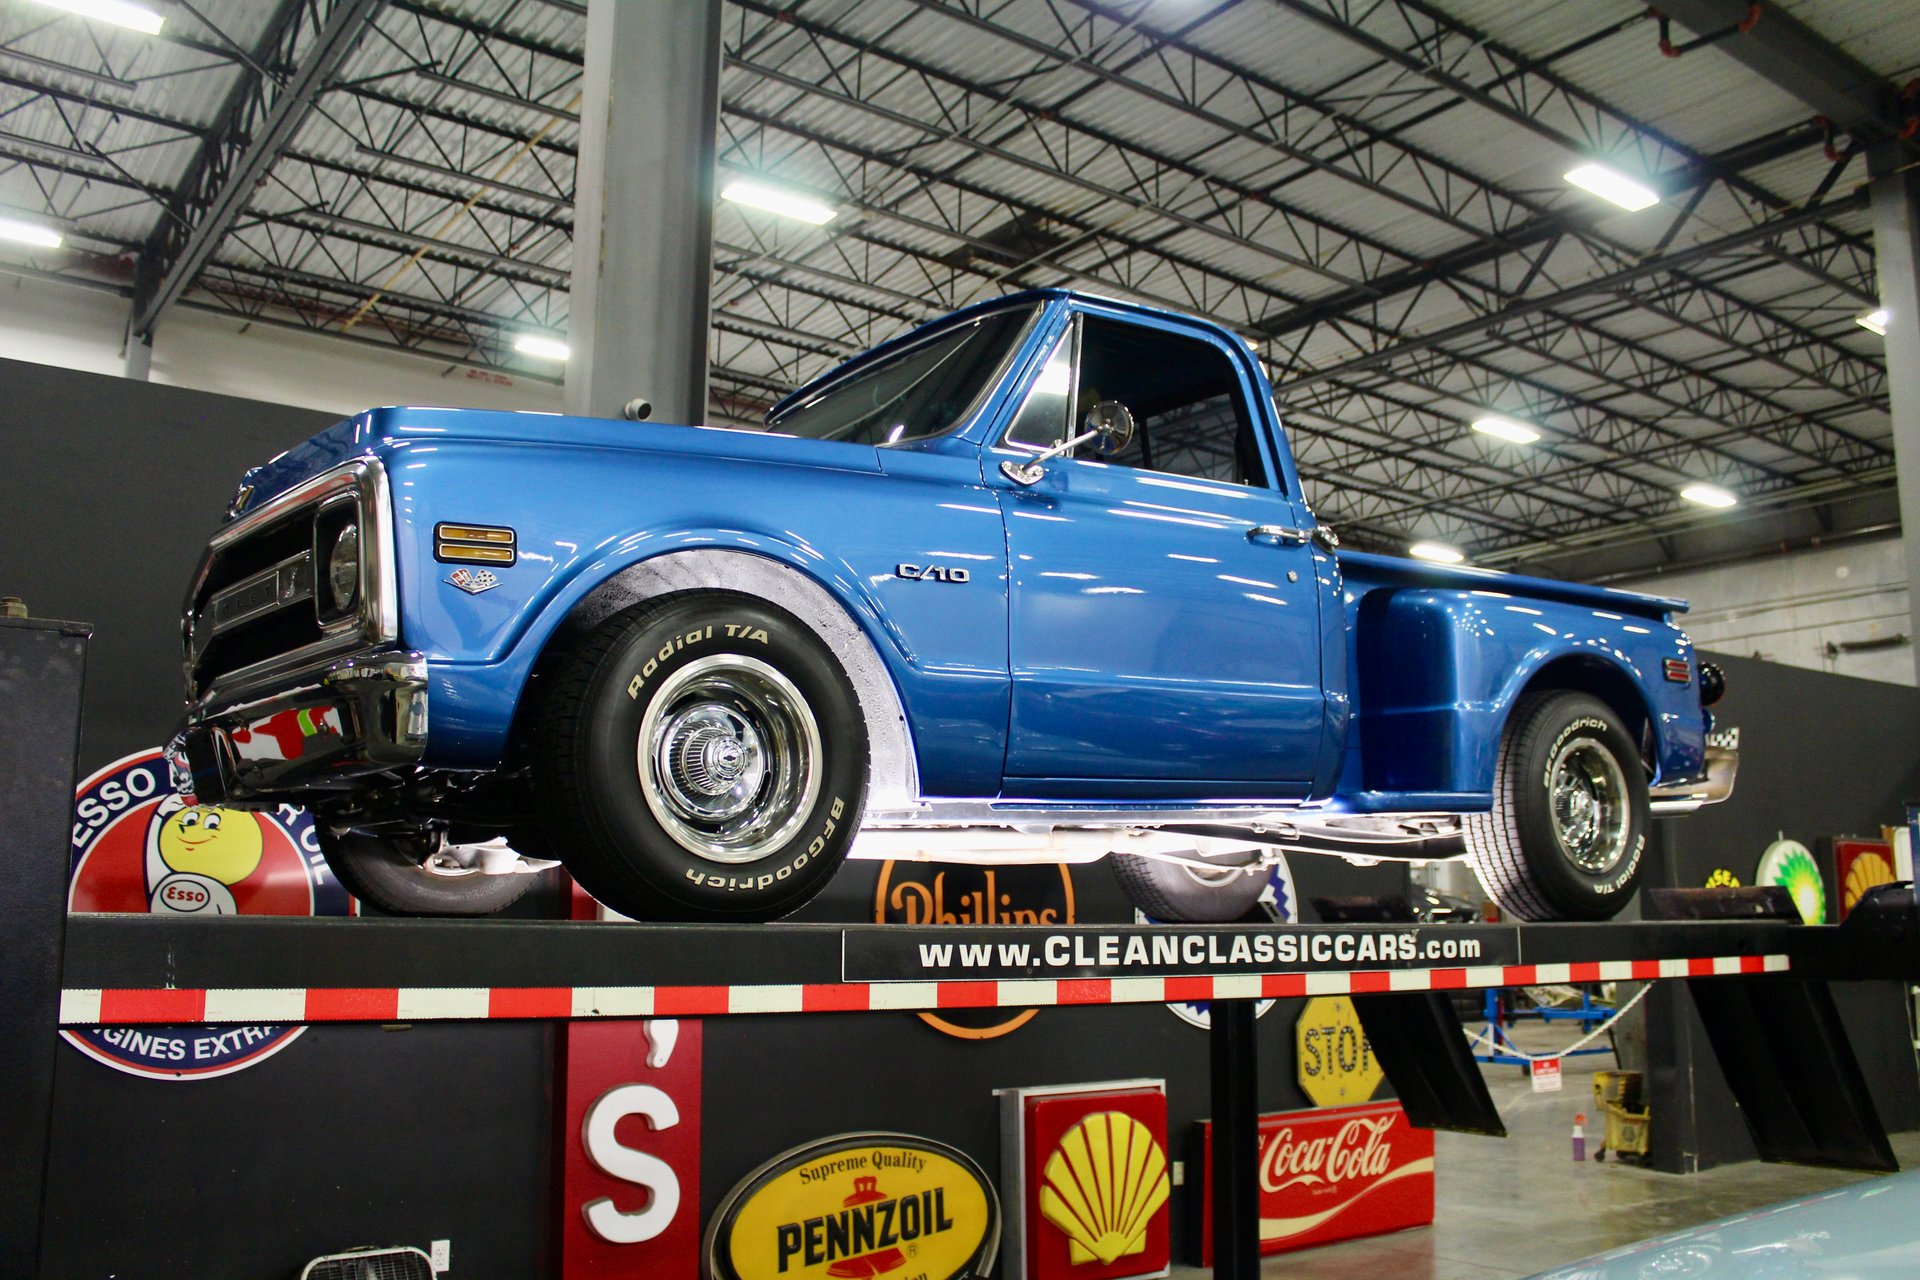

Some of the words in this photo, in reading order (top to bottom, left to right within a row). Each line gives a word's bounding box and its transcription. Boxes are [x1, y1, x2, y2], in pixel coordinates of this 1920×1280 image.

[898, 563, 970, 583] C/10
[626, 624, 713, 701] Radial
[724, 623, 769, 645] T/A
[72, 767, 156, 849] ESSO
[685, 796, 845, 892] BFGoodrich
[918, 934, 1482, 968] www.CLEANCLASSICCARS.com
[93, 1028, 186, 1061] GINES
[799, 1156, 868, 1186] Supreme
[871, 1150, 927, 1173] Quality
[1259, 1114, 1397, 1194] Coca-Cola
[776, 1186, 954, 1274] PENNZOIL
